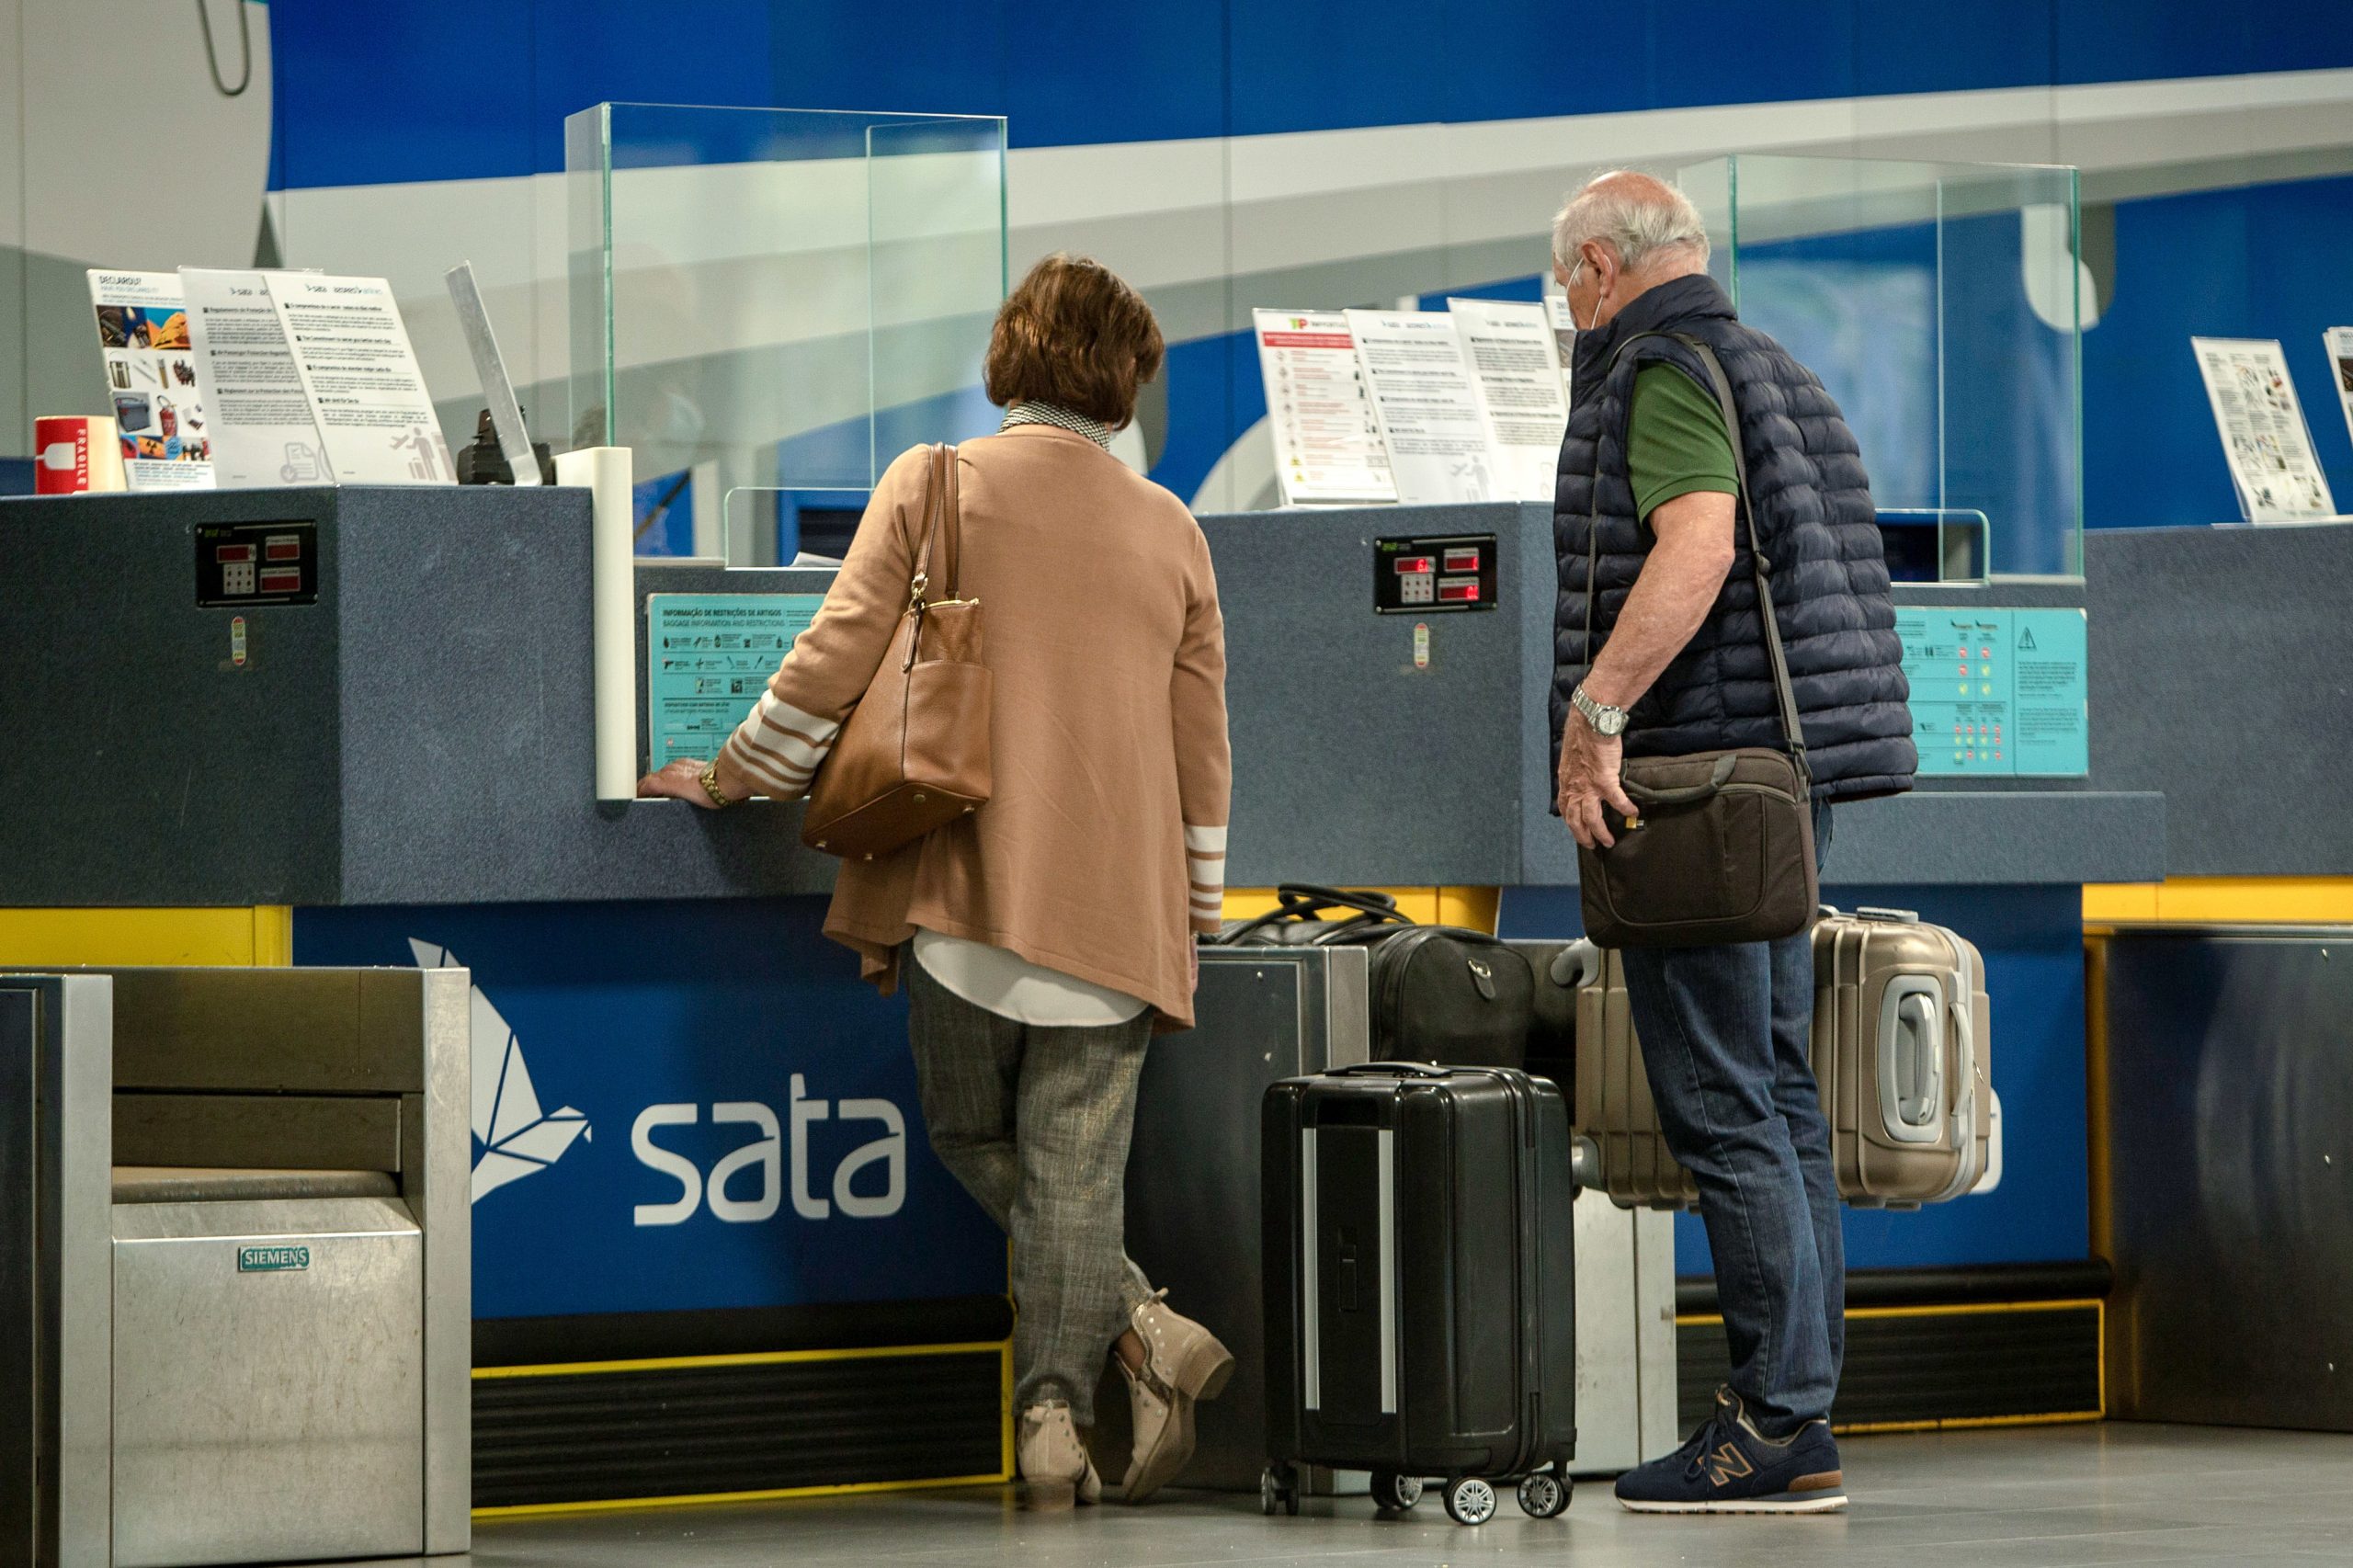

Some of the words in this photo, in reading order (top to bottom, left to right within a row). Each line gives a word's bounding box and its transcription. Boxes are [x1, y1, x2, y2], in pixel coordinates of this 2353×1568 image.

[76, 428, 87, 485] FRAGILE
[631, 1073, 906, 1226] sata
[244, 1249, 307, 1266] SIEMENS
